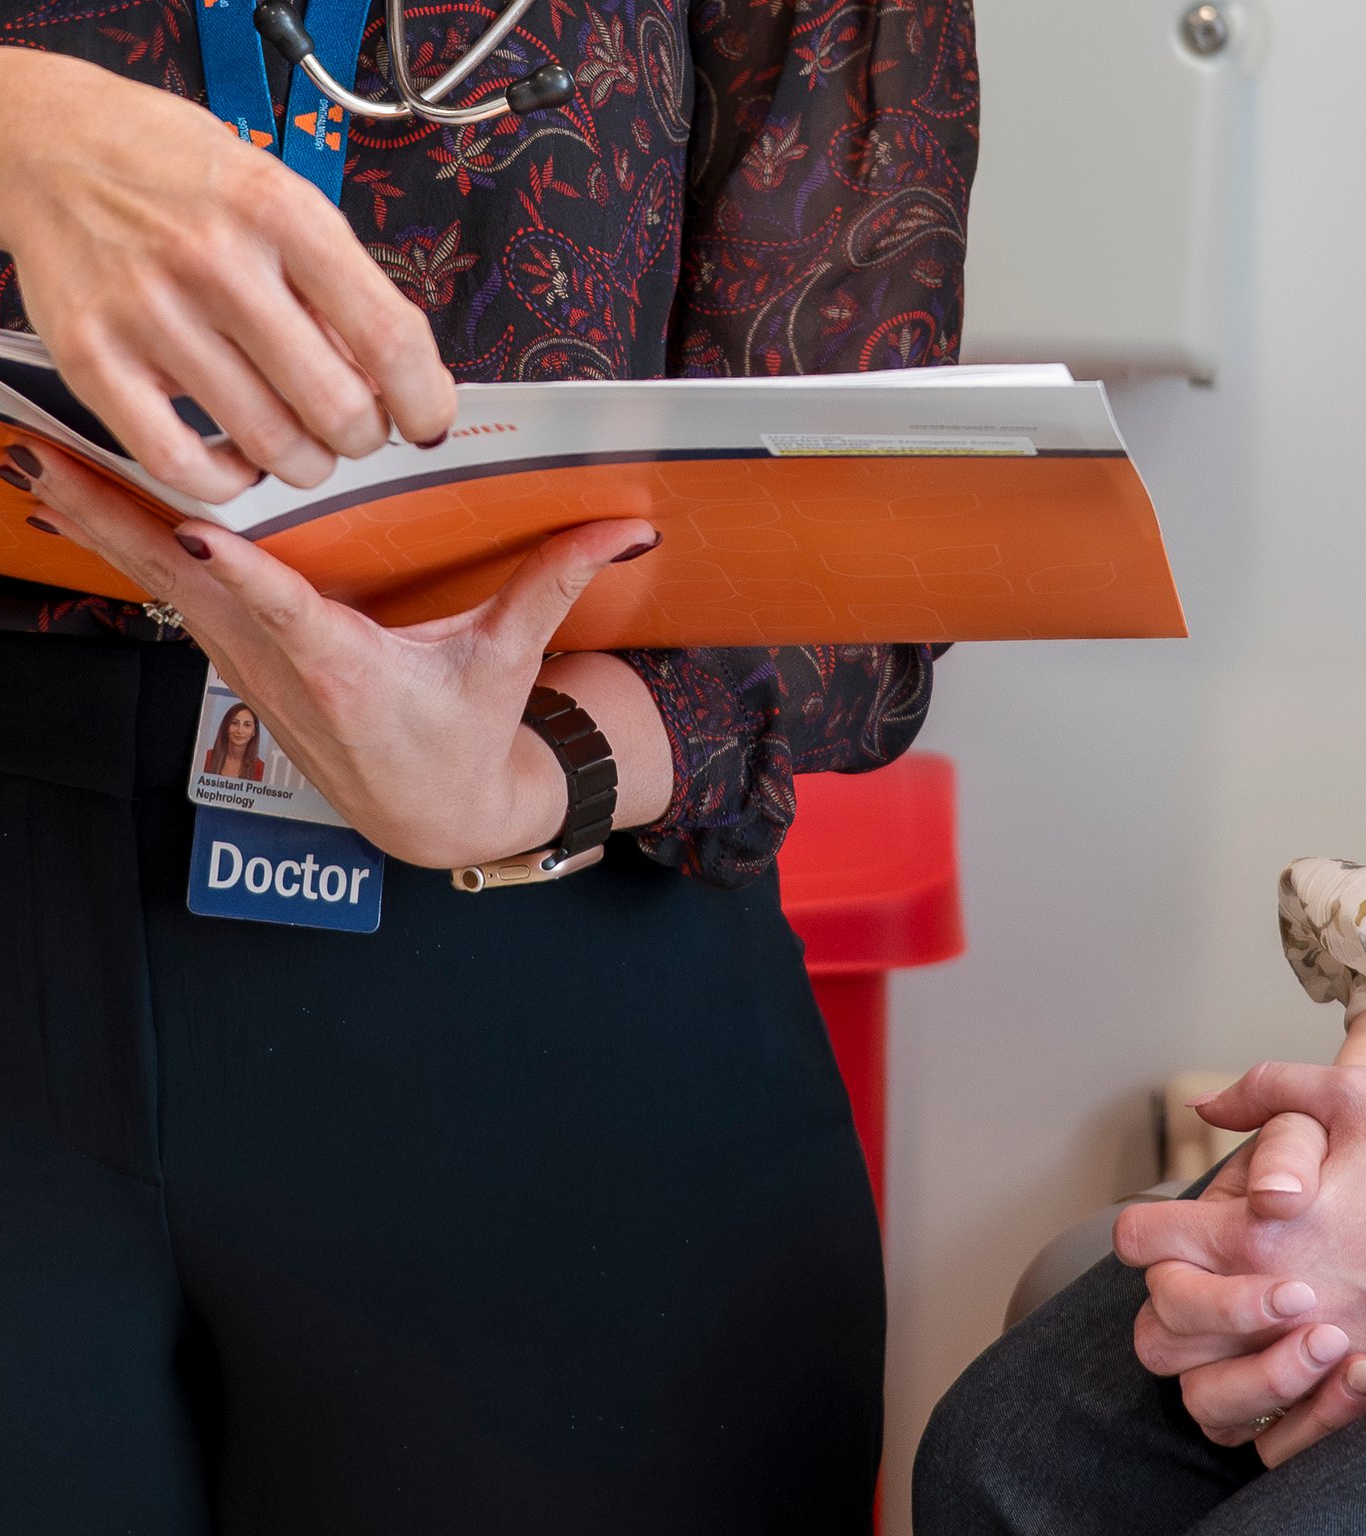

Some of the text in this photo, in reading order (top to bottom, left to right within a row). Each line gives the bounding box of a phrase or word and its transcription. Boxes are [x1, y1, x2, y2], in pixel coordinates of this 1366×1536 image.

[315, 98, 329, 151] OPHTHALMOLOGY
[452, 422, 517, 437] alth
[196, 788, 255, 809] Nephrology
[198, 775, 294, 800] Assistant Professor
[208, 840, 370, 904] Doctor
